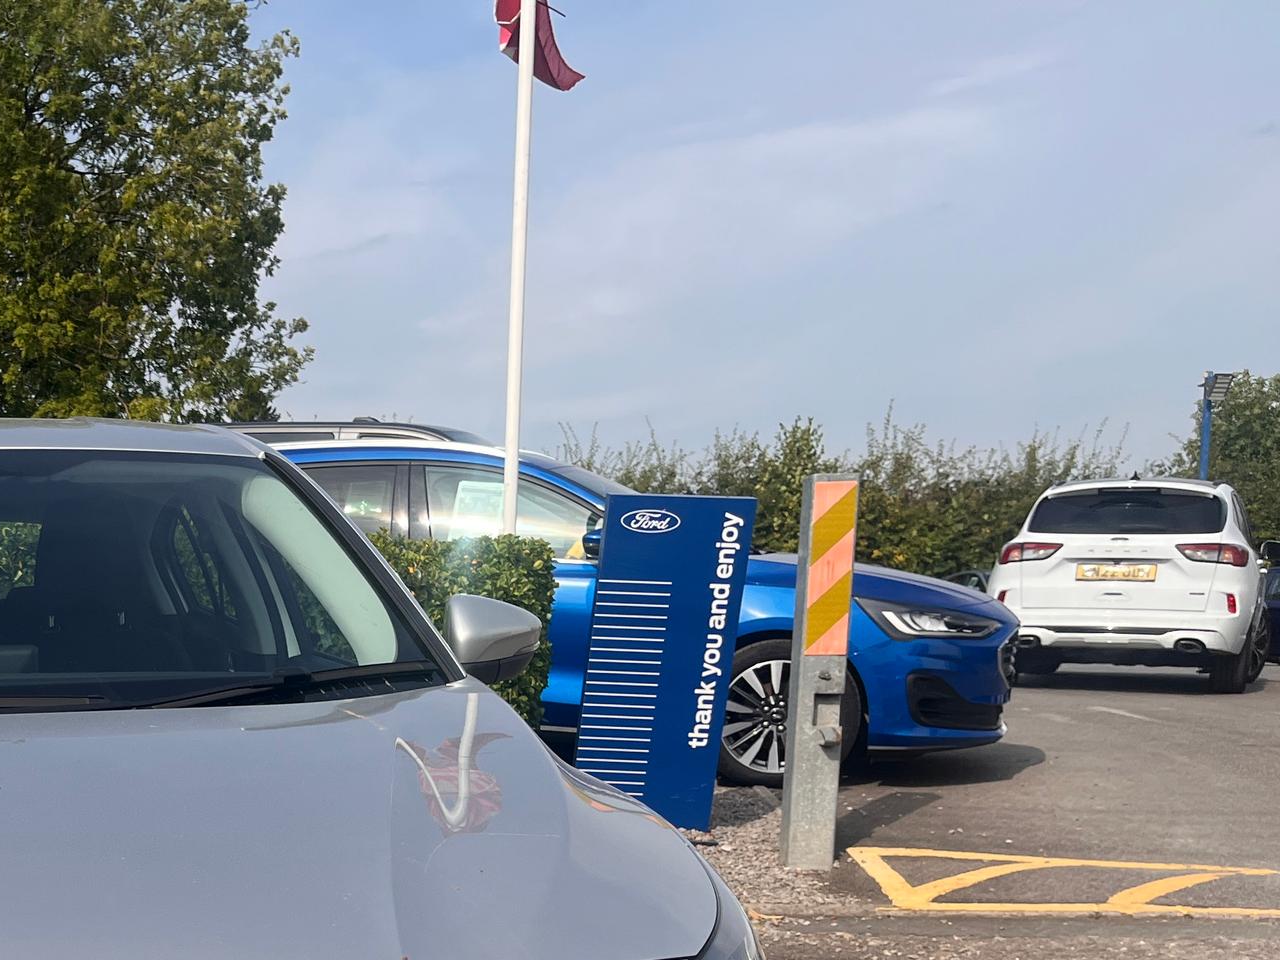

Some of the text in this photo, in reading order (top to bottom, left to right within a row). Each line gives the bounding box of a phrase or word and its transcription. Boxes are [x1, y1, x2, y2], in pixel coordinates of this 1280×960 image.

[630, 511, 671, 530] Ford
[687, 511, 745, 749] thank you and enjoy
